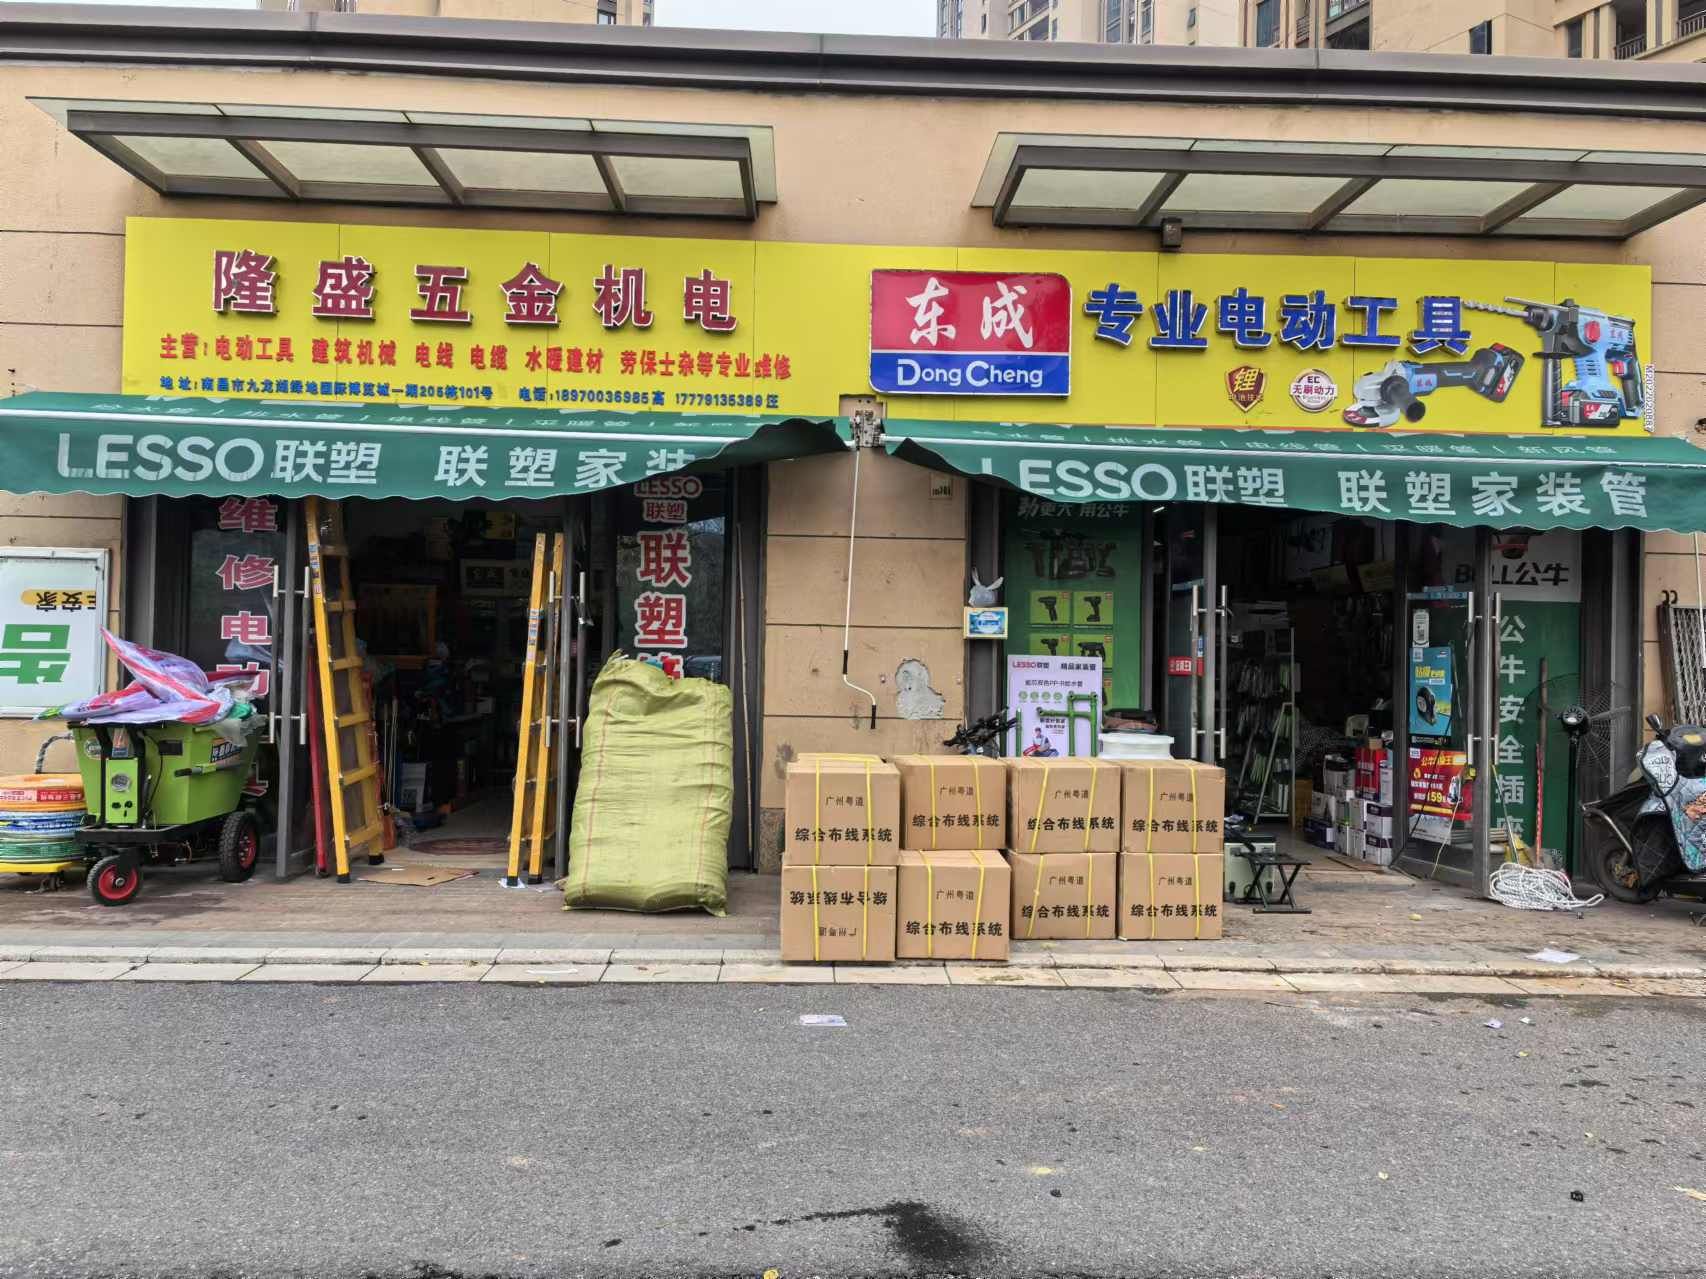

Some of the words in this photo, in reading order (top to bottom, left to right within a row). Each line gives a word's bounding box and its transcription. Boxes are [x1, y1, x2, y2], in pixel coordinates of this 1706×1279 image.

[211, 248, 737, 331] 隆盛五金机电
[905, 277, 1034, 349] 东成
[1083, 282, 1473, 357] 专业电动工具
[311, 337, 397, 367] 建筑机械
[415, 341, 453, 369] 电线
[470, 344, 508, 370] 电缆
[525, 346, 604, 374] 水暖建材
[896, 358, 1044, 388] DongCheng
[1232, 367, 1260, 392] 锂
[56, 432, 265, 483] LESSO
[270, 439, 383, 485] 联塑
[1183, 464, 1289, 506] 联塑
[1337, 469, 1649, 519] 联塑家装管
[645, 500, 686, 521] 联塑
[1515, 561, 1570, 586] 公牛
[911, 814, 1000, 829] 综合布线系统
[1027, 816, 1115, 831] 综合布线系统
[1131, 819, 1219, 834] 综合布线系统
[794, 828, 893, 843] 综合布线系统
[1021, 904, 1110, 919] 综合布线系统
[1130, 903, 1218, 919] 综合布线系统
[905, 920, 1004, 937] 综合布线系统
